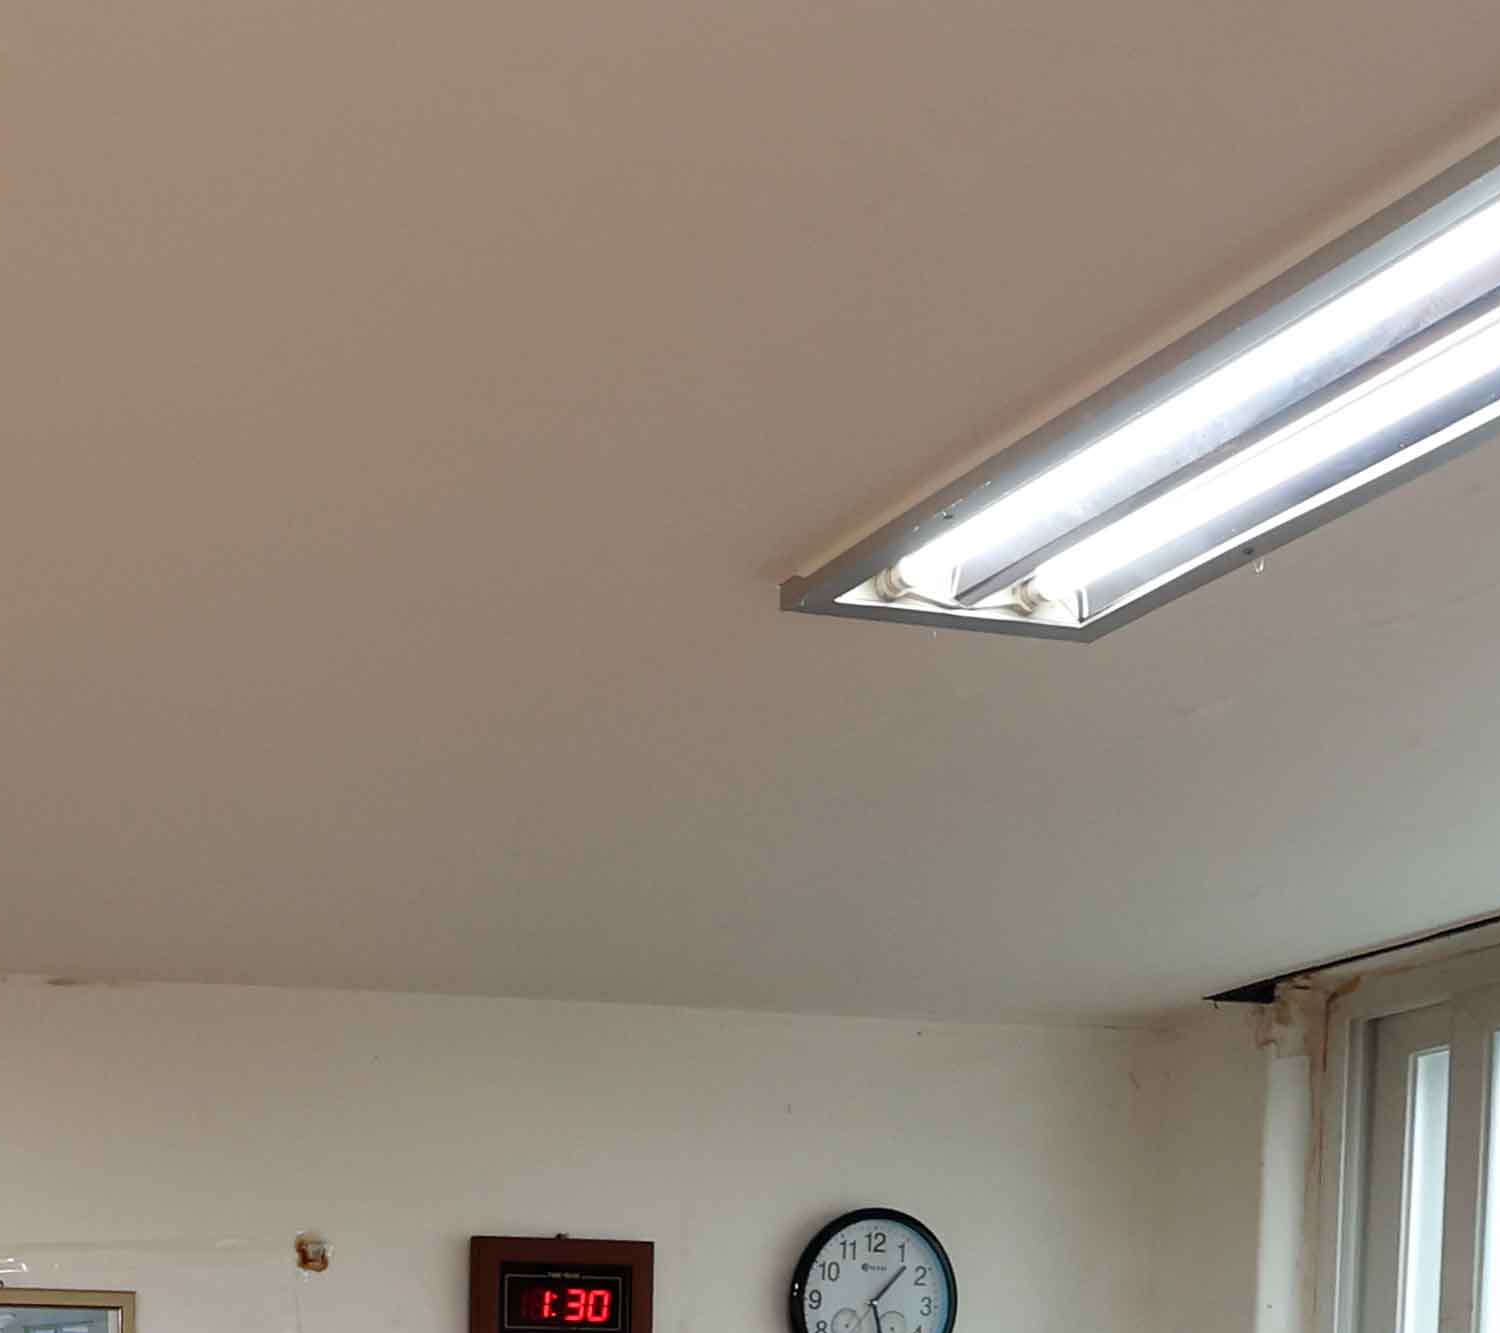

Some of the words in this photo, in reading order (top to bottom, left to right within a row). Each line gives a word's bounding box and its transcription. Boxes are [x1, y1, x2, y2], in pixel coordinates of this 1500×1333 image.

[840, 1240, 857, 1261] 11
[864, 1232, 887, 1253] 12
[897, 1244, 906, 1263] 1
[819, 1261, 840, 1282] 10
[914, 1266, 927, 1286] 2
[542, 1288, 612, 1322] 1:30
[809, 1289, 823, 1310] 9
[920, 1296, 932, 1317] 3
